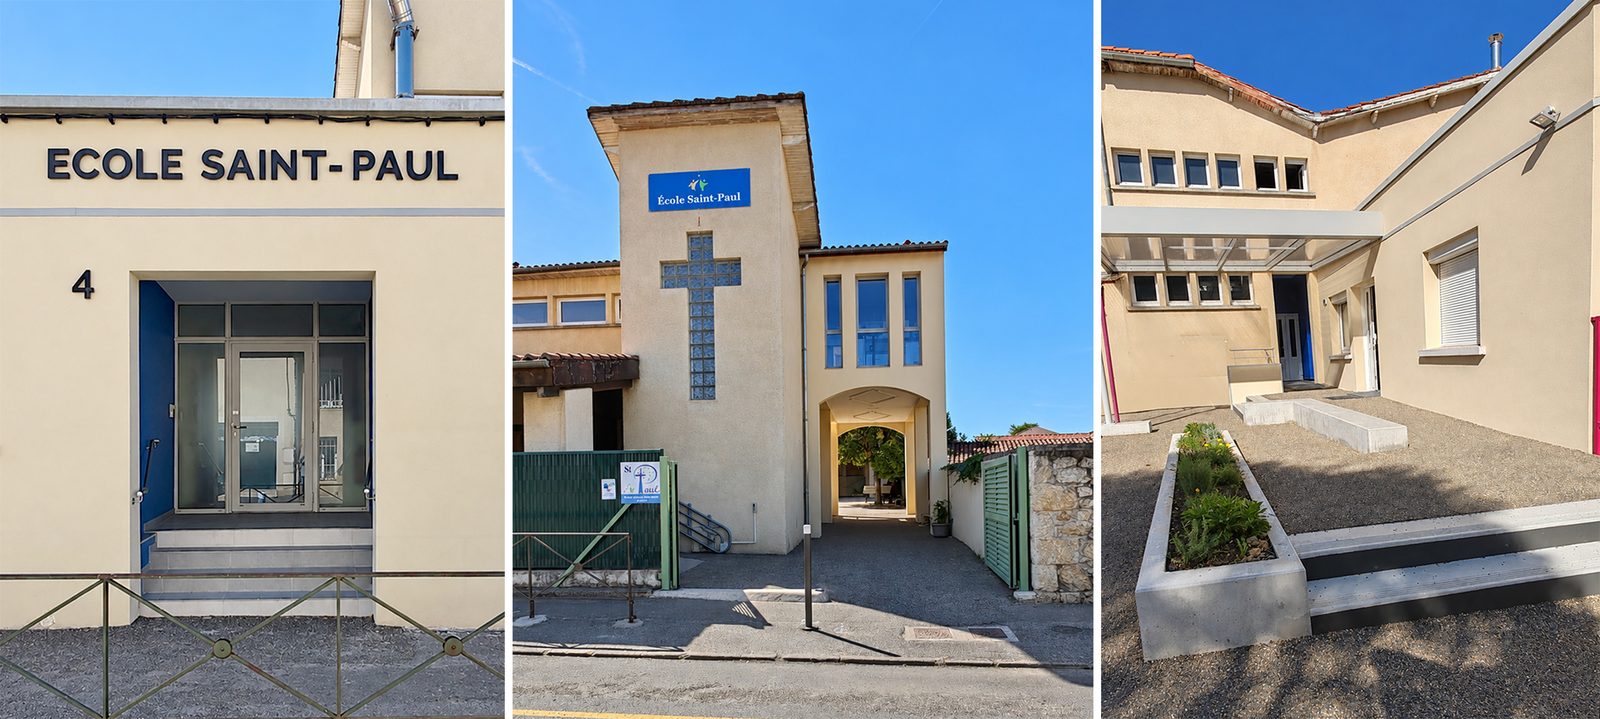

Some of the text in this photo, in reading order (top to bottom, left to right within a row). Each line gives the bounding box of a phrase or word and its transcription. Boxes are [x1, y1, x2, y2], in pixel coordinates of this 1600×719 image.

[47, 148, 459, 181] ECOLE SAINT-PAUL
[657, 191, 741, 206] École Saint-Paul
[71, 269, 95, 300] 4
[624, 465, 632, 473] St
